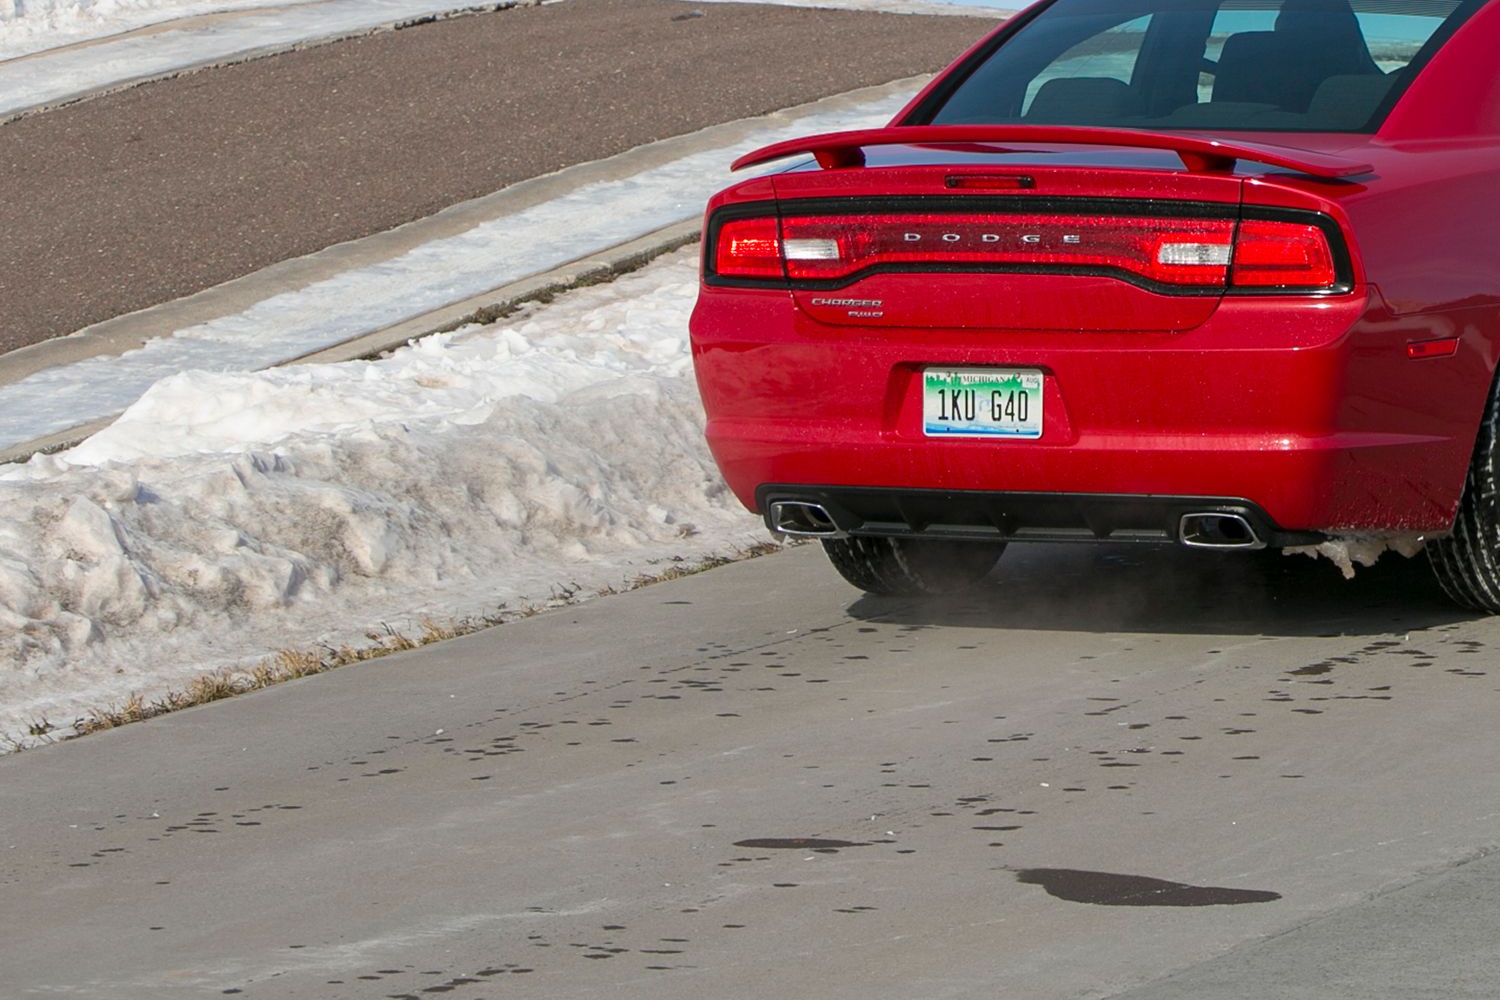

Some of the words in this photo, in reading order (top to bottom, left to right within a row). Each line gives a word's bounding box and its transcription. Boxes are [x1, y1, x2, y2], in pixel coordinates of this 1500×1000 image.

[903, 232, 1080, 243] DODGE
[811, 298, 882, 307] CHARGER
[962, 375, 1005, 384] MICHIGAN
[938, 389, 976, 421] 1KU
[991, 389, 1029, 422] G40
